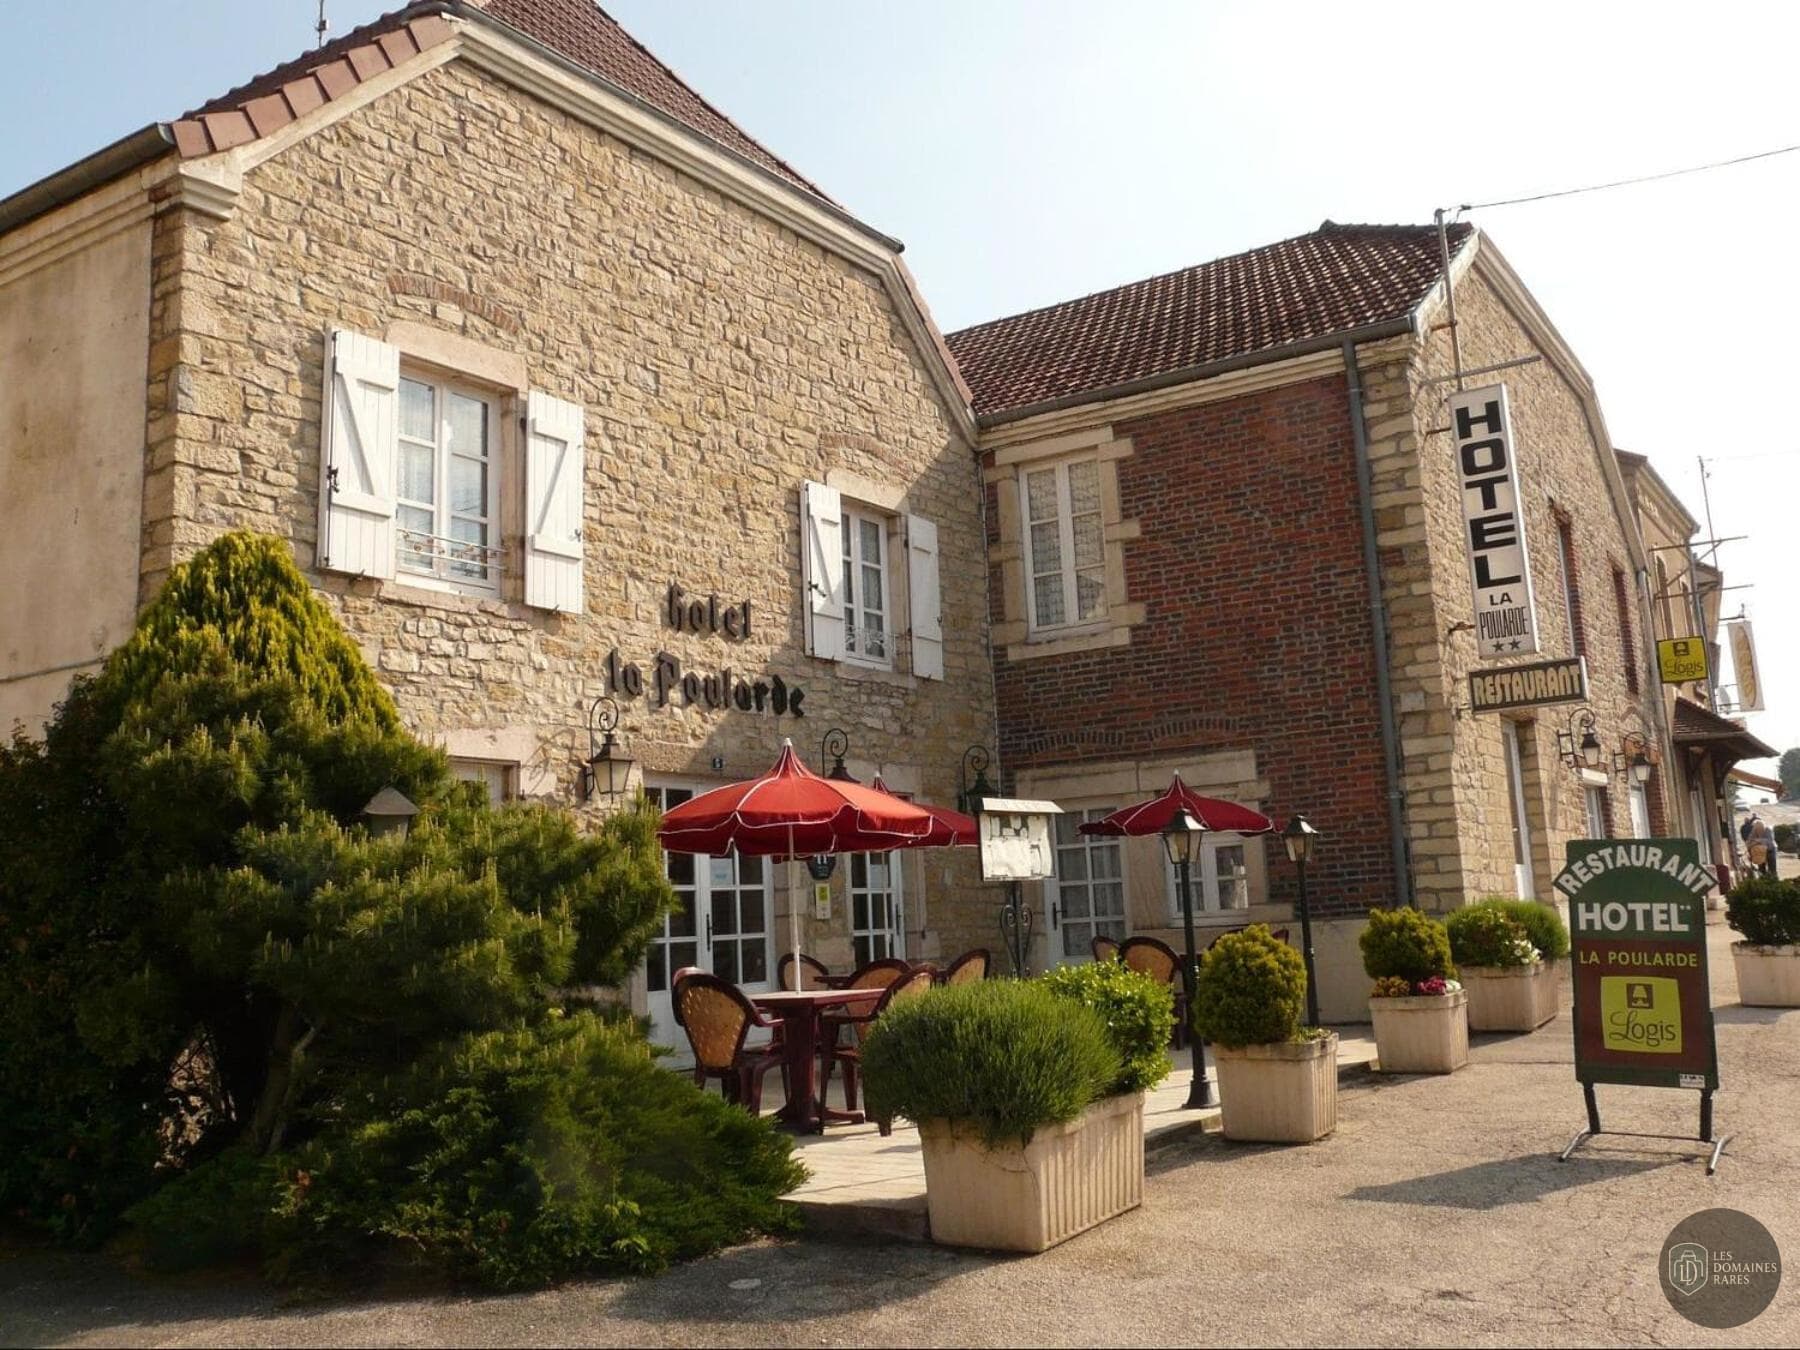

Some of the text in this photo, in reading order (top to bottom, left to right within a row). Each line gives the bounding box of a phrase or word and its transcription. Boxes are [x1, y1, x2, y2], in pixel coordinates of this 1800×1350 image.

[1455, 400, 1522, 589] HOTEL
[1489, 592, 1513, 606] LA
[1479, 606, 1530, 640] POULARDE
[609, 650, 805, 718] la Poularde
[1474, 665, 1582, 704] RESTAURANT
[1664, 659, 1704, 676] Logis
[1559, 845, 1714, 895] RESTAURANT
[1577, 902, 1690, 932] HOTEL
[1580, 951, 1698, 967] LA POULARDE
[1608, 1010, 1677, 1047] Logis
